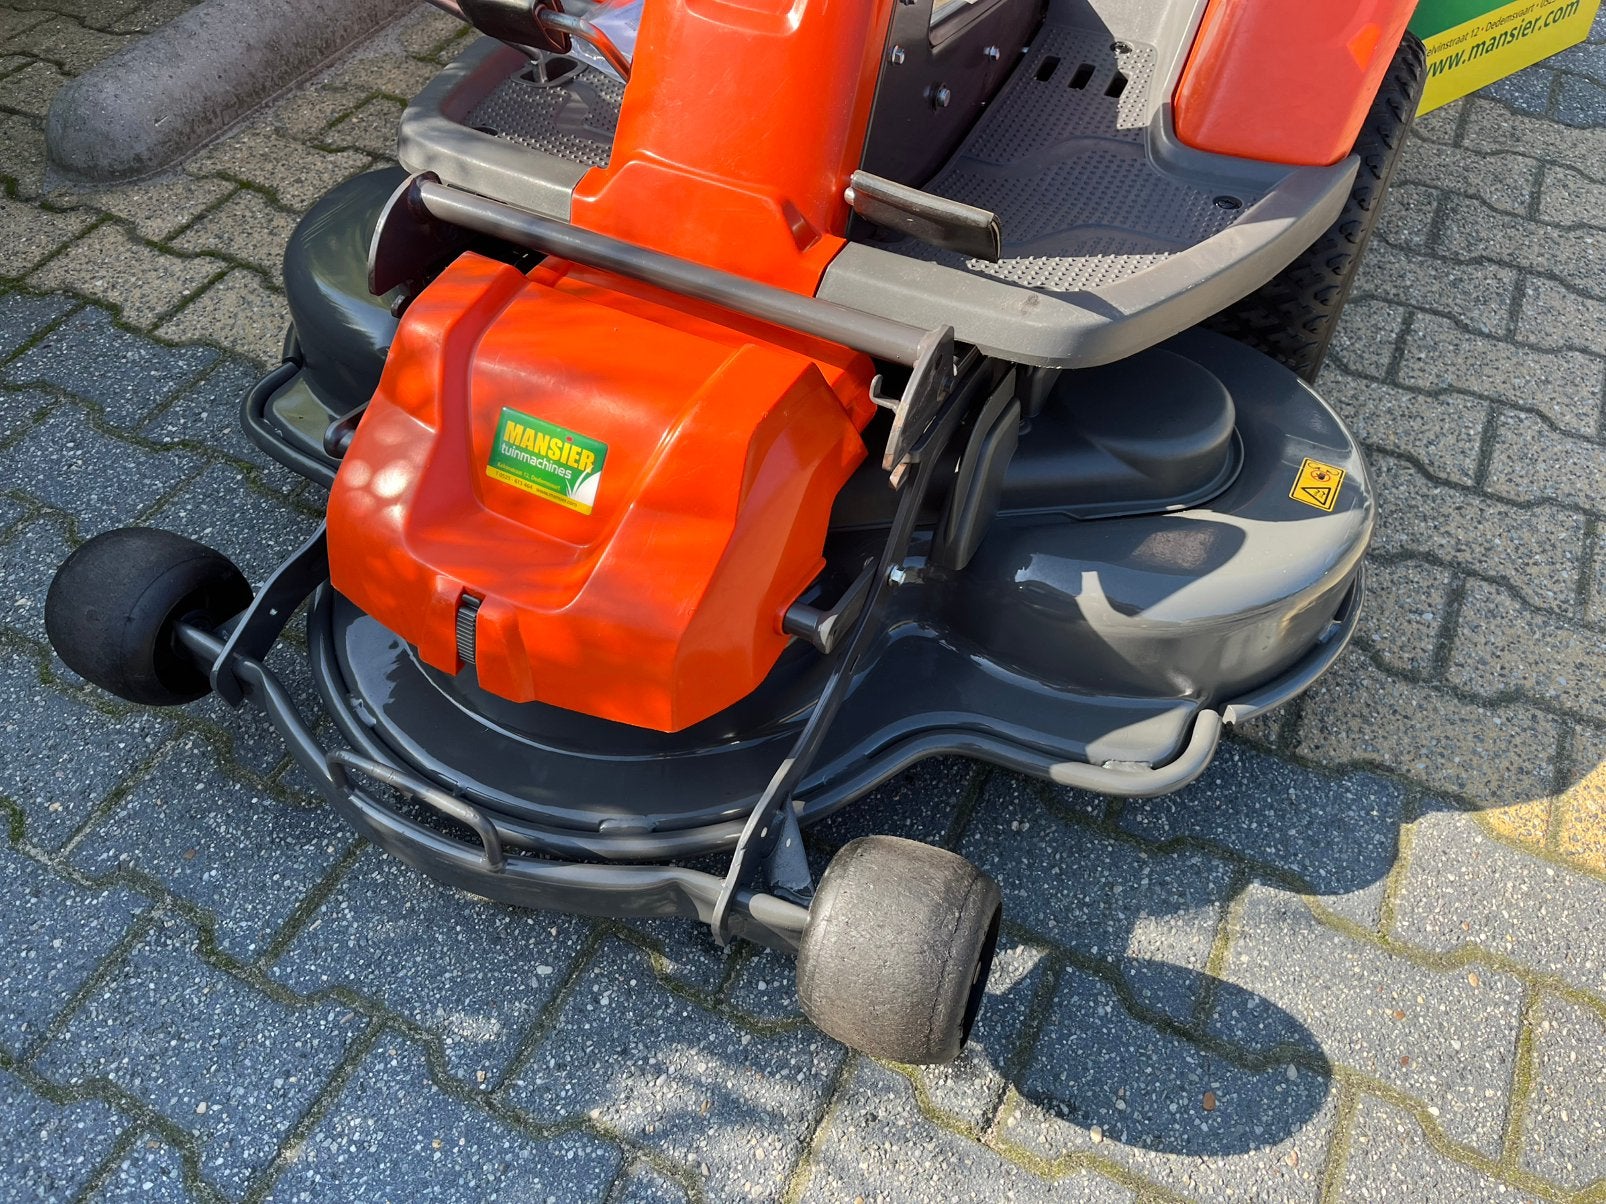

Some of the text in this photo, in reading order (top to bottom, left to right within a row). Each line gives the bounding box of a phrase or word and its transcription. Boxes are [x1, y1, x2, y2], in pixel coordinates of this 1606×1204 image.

[1470, 26, 1480, 38] 12
[501, 442, 573, 480] tuinmachines
[503, 420, 595, 474] MANSIER
